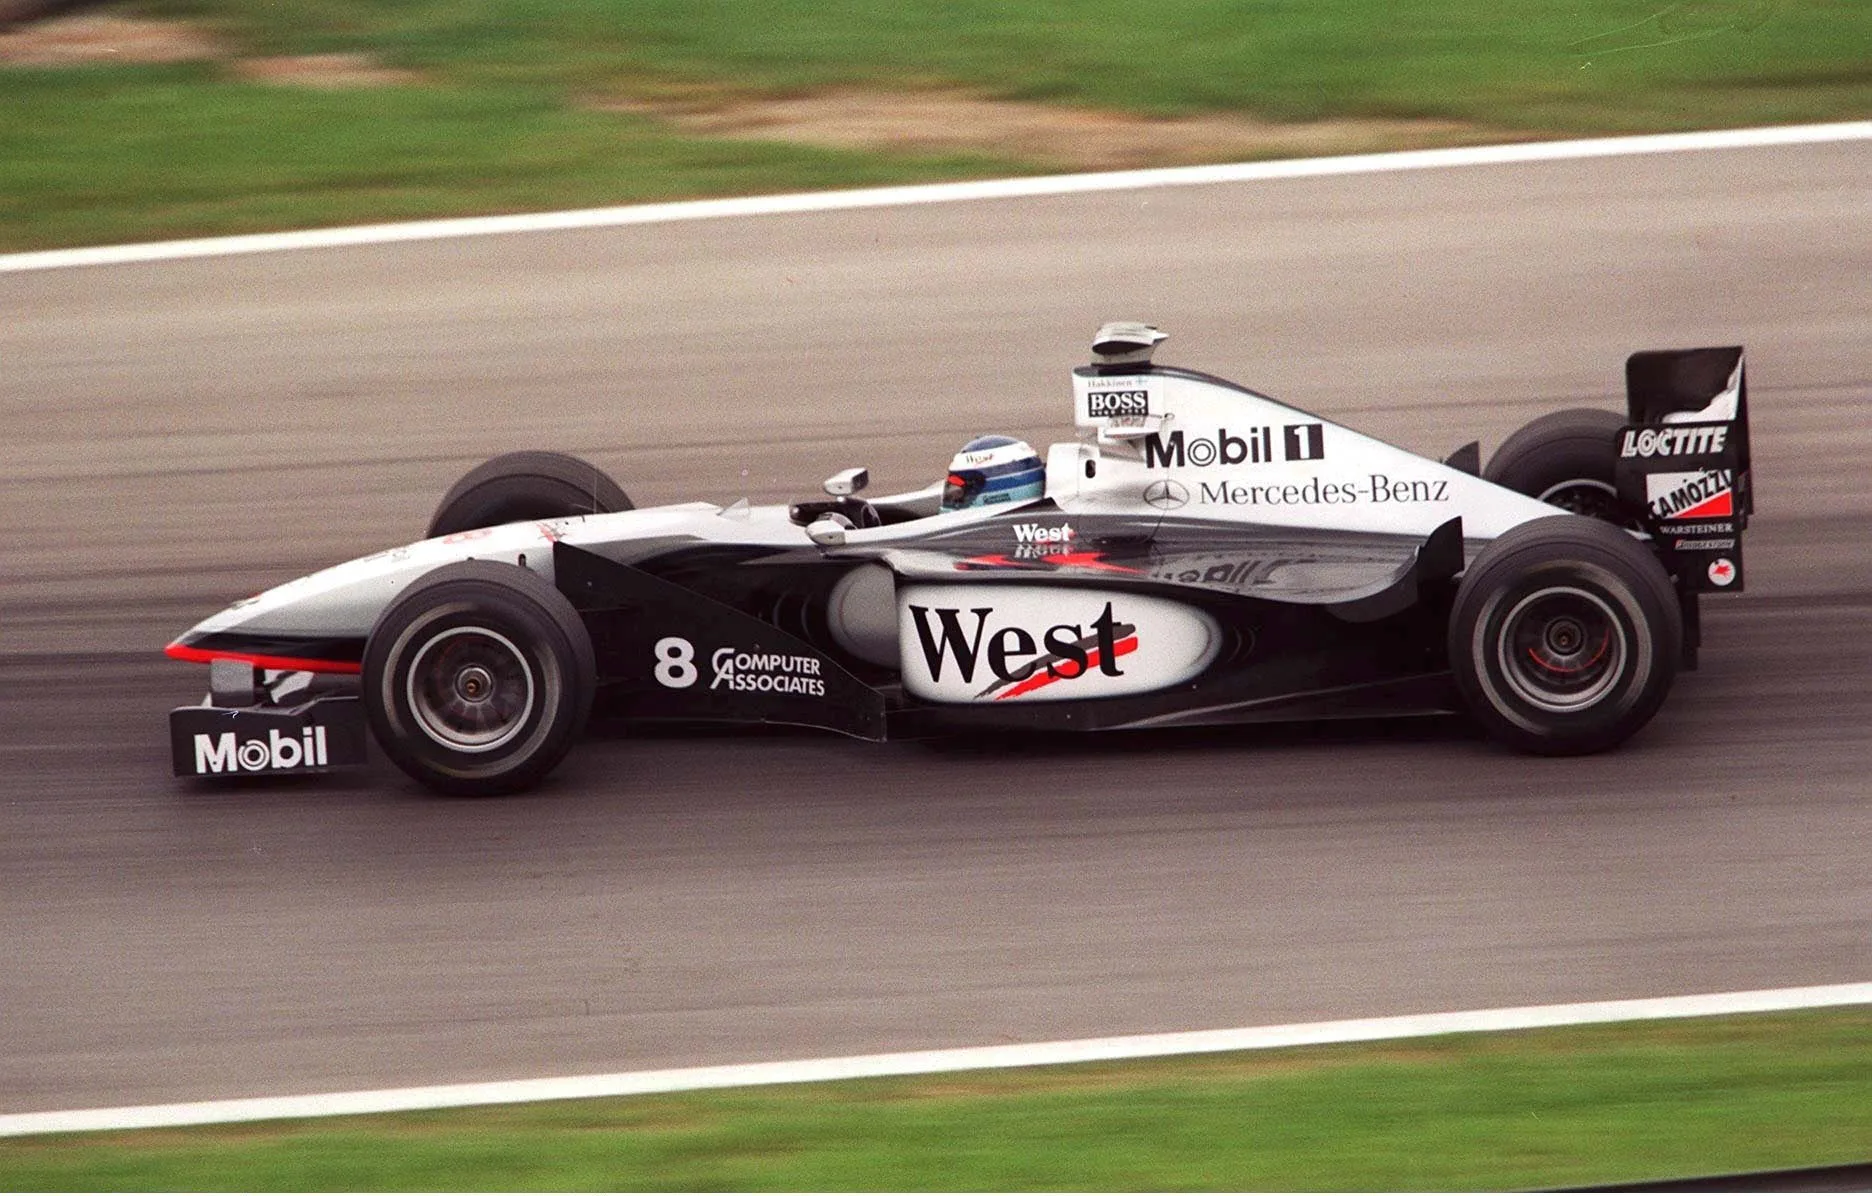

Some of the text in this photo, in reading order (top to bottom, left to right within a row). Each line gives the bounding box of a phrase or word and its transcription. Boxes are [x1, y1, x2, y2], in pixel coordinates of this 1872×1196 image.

[1091, 392, 1146, 410] BOSS
[1145, 426, 1272, 468] Mobil
[1621, 426, 1728, 458] LOCTITE
[1200, 474, 1449, 504] Mercedes-Benz
[1012, 523, 1071, 543] West
[1660, 523, 1734, 535] WARSTEINER
[909, 601, 1123, 684] West
[654, 637, 697, 689] 8
[712, 648, 820, 675] COMPUTER
[710, 659, 825, 697] ASSOCIATES
[194, 726, 328, 773] Mobil
